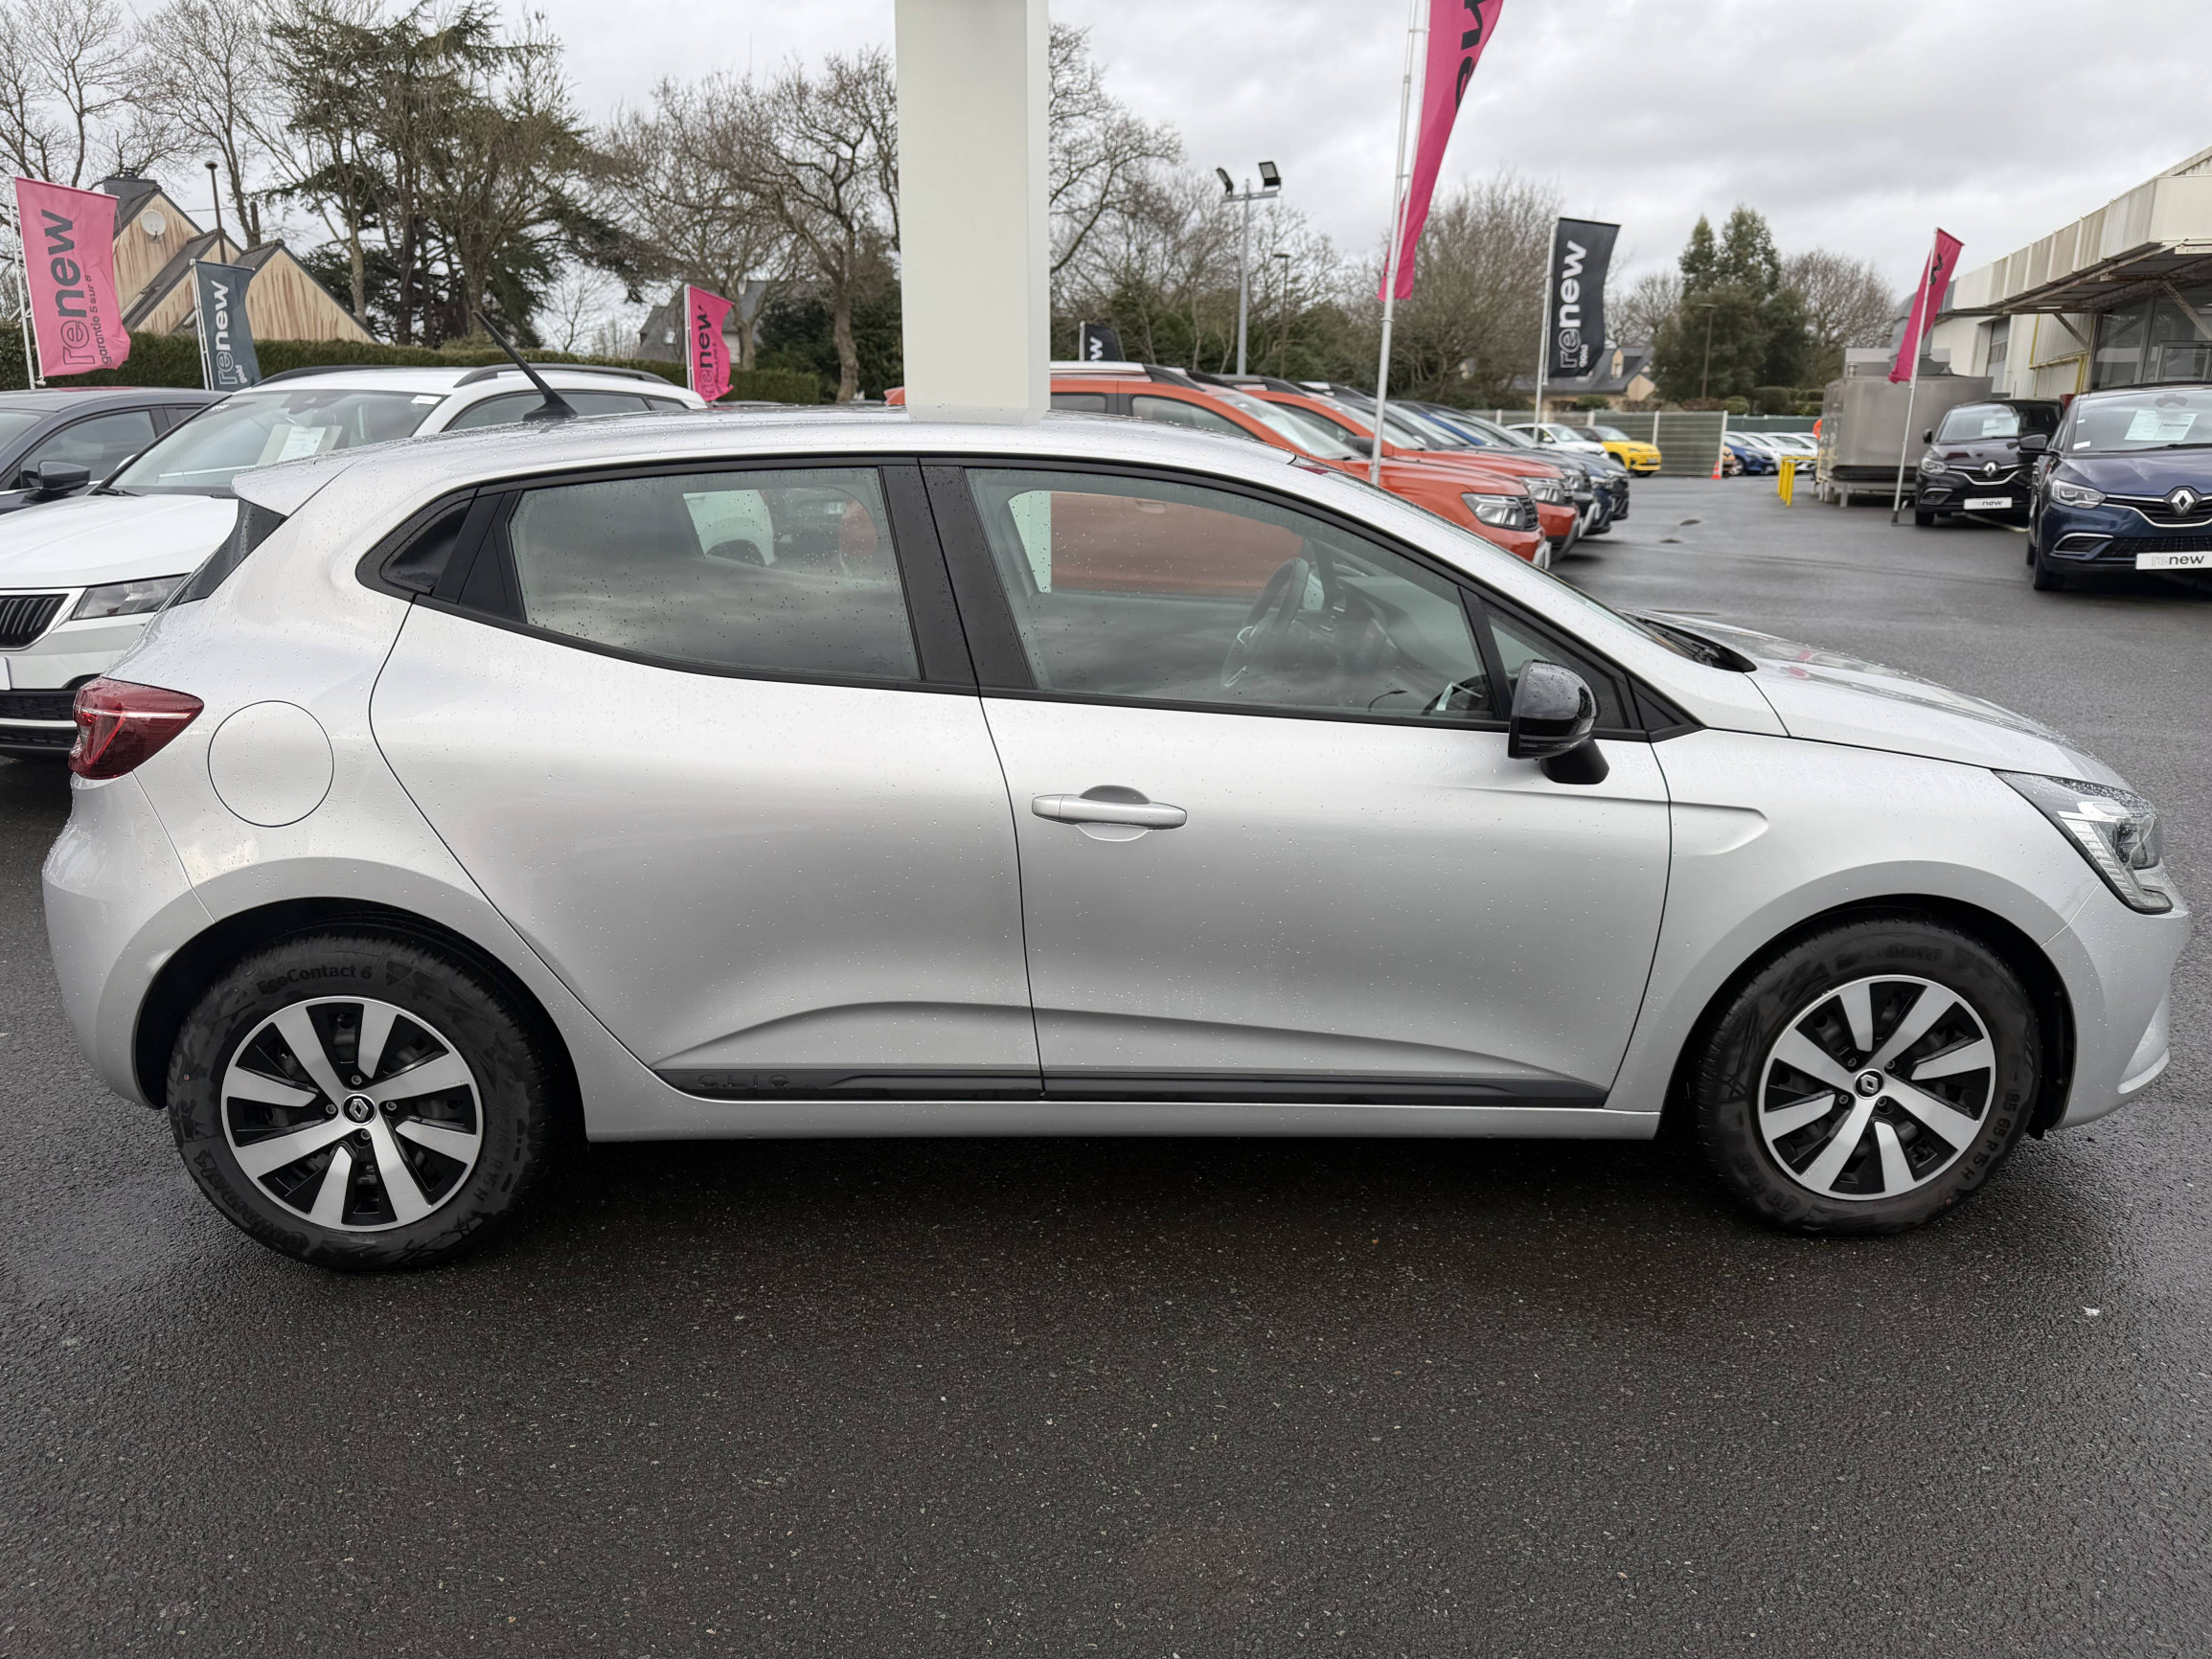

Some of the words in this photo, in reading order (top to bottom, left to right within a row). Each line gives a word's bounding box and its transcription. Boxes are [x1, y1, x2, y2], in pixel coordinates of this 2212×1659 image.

[41, 209, 96, 365] renew
[88, 284, 97, 304] sur
[1559, 239, 1587, 369] renew
[91, 315, 112, 364] garantie
[211, 280, 238, 385] renew
[256, 965, 356, 995] EcoContact
[360, 966, 373, 979] 6
[697, 1074, 789, 1088] CLIO
[1993, 1118, 2011, 1137] 65
[1986, 1139, 1999, 1151] R
[1973, 1151, 1990, 1167] 15
[1960, 1166, 1975, 1180] H
